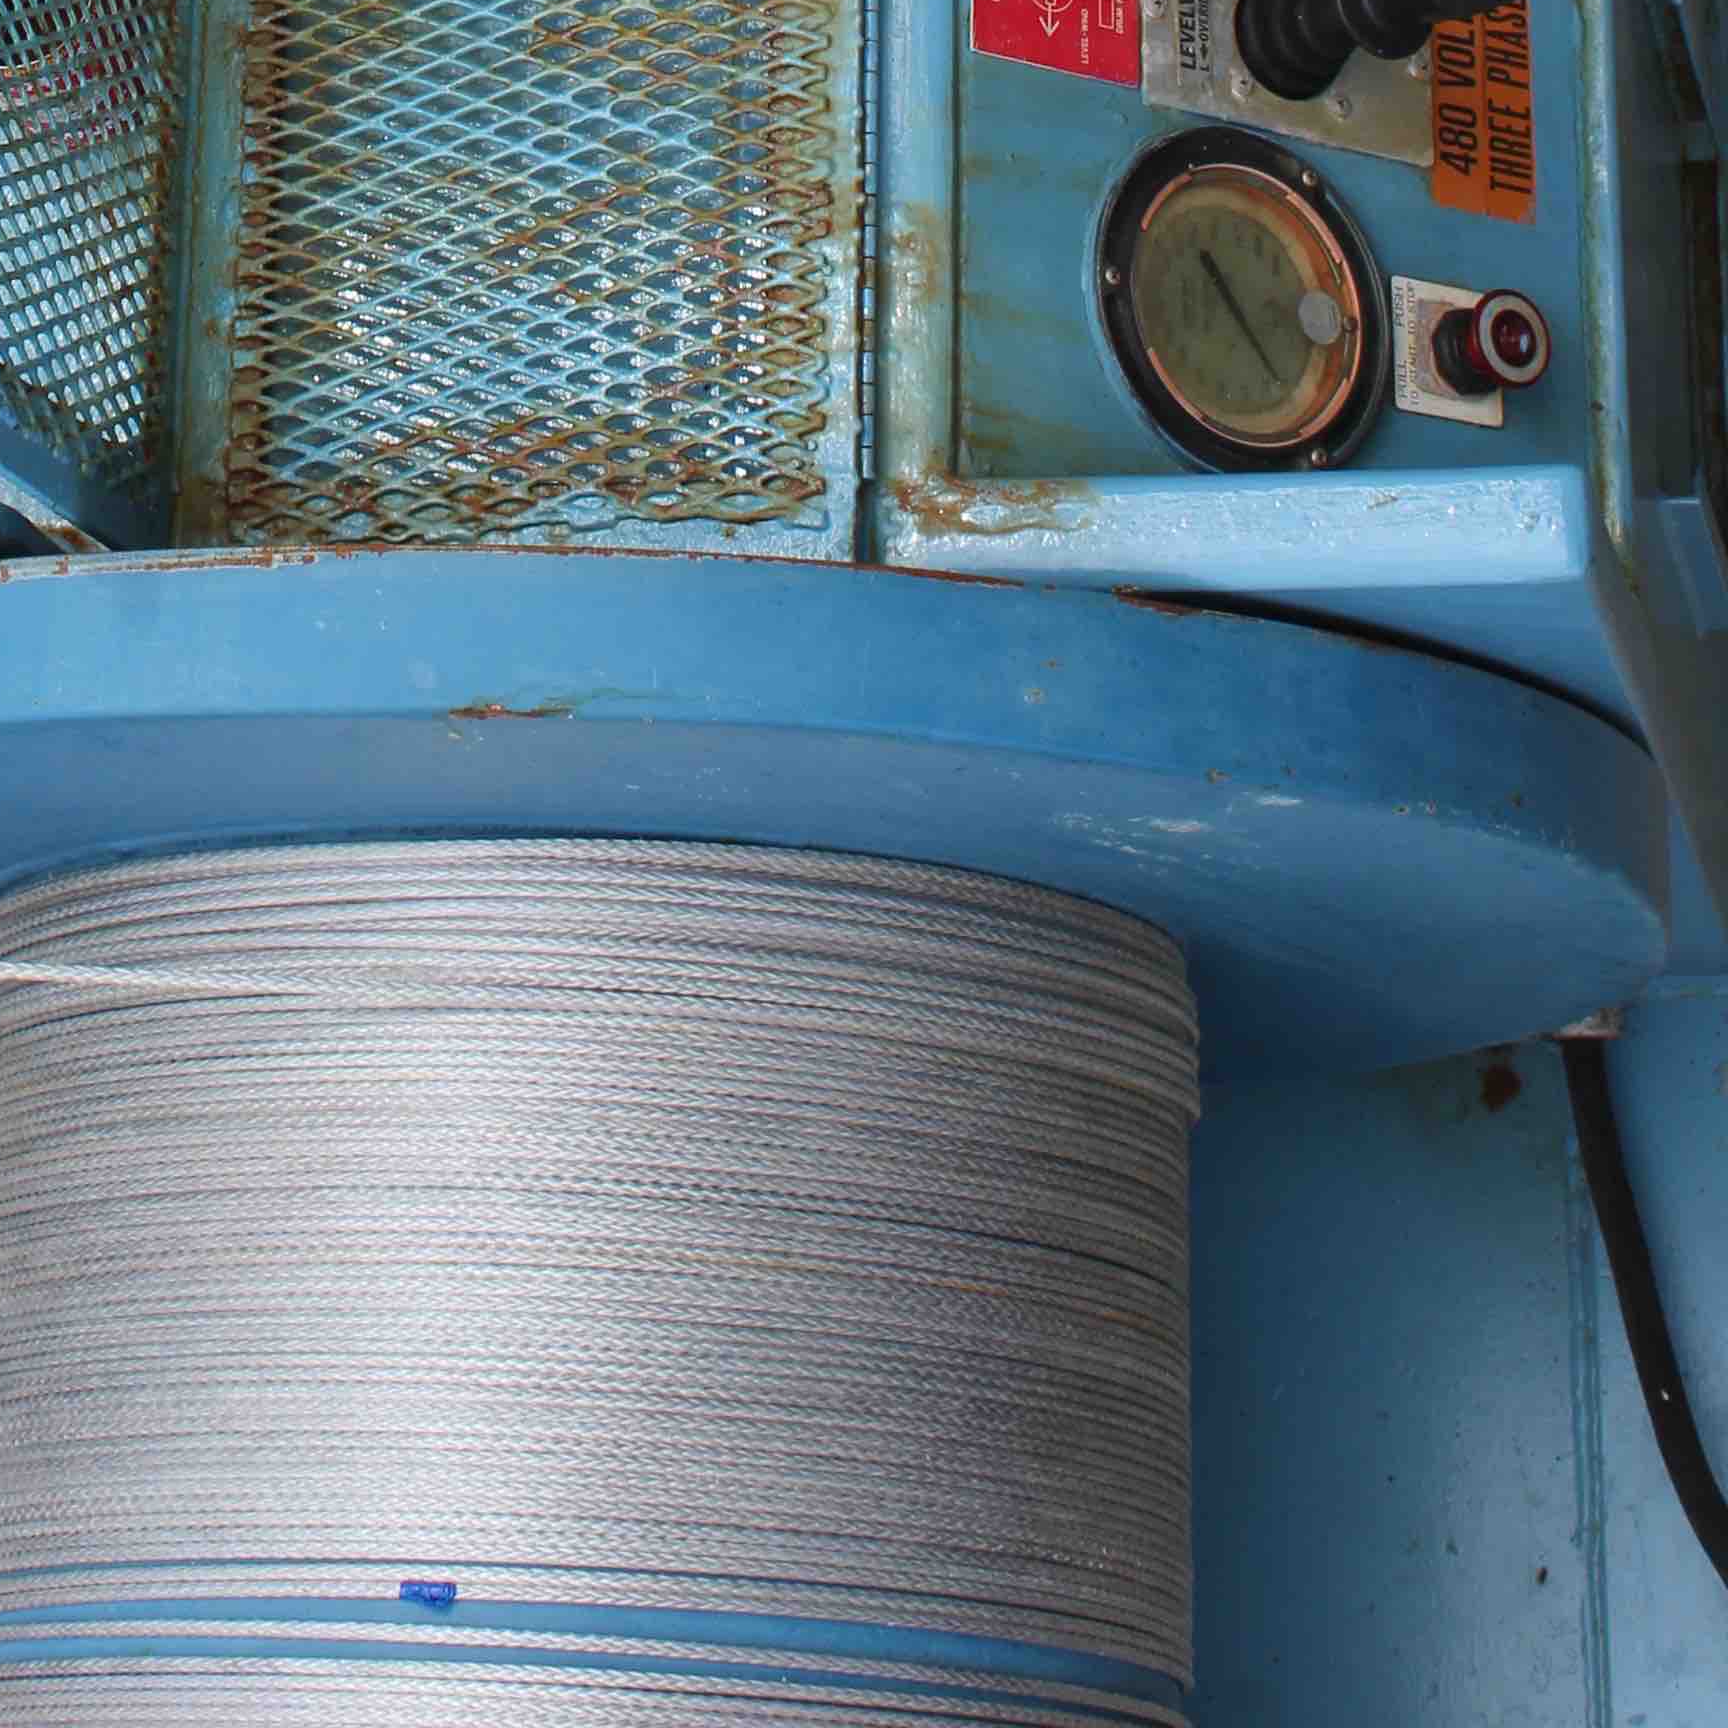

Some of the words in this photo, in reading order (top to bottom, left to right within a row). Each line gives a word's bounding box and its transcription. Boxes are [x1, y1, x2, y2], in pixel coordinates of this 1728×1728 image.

[1437, 19, 1476, 88] VOL
[1438, 102, 1478, 177] 480
[1488, 99, 1534, 195] THREE
